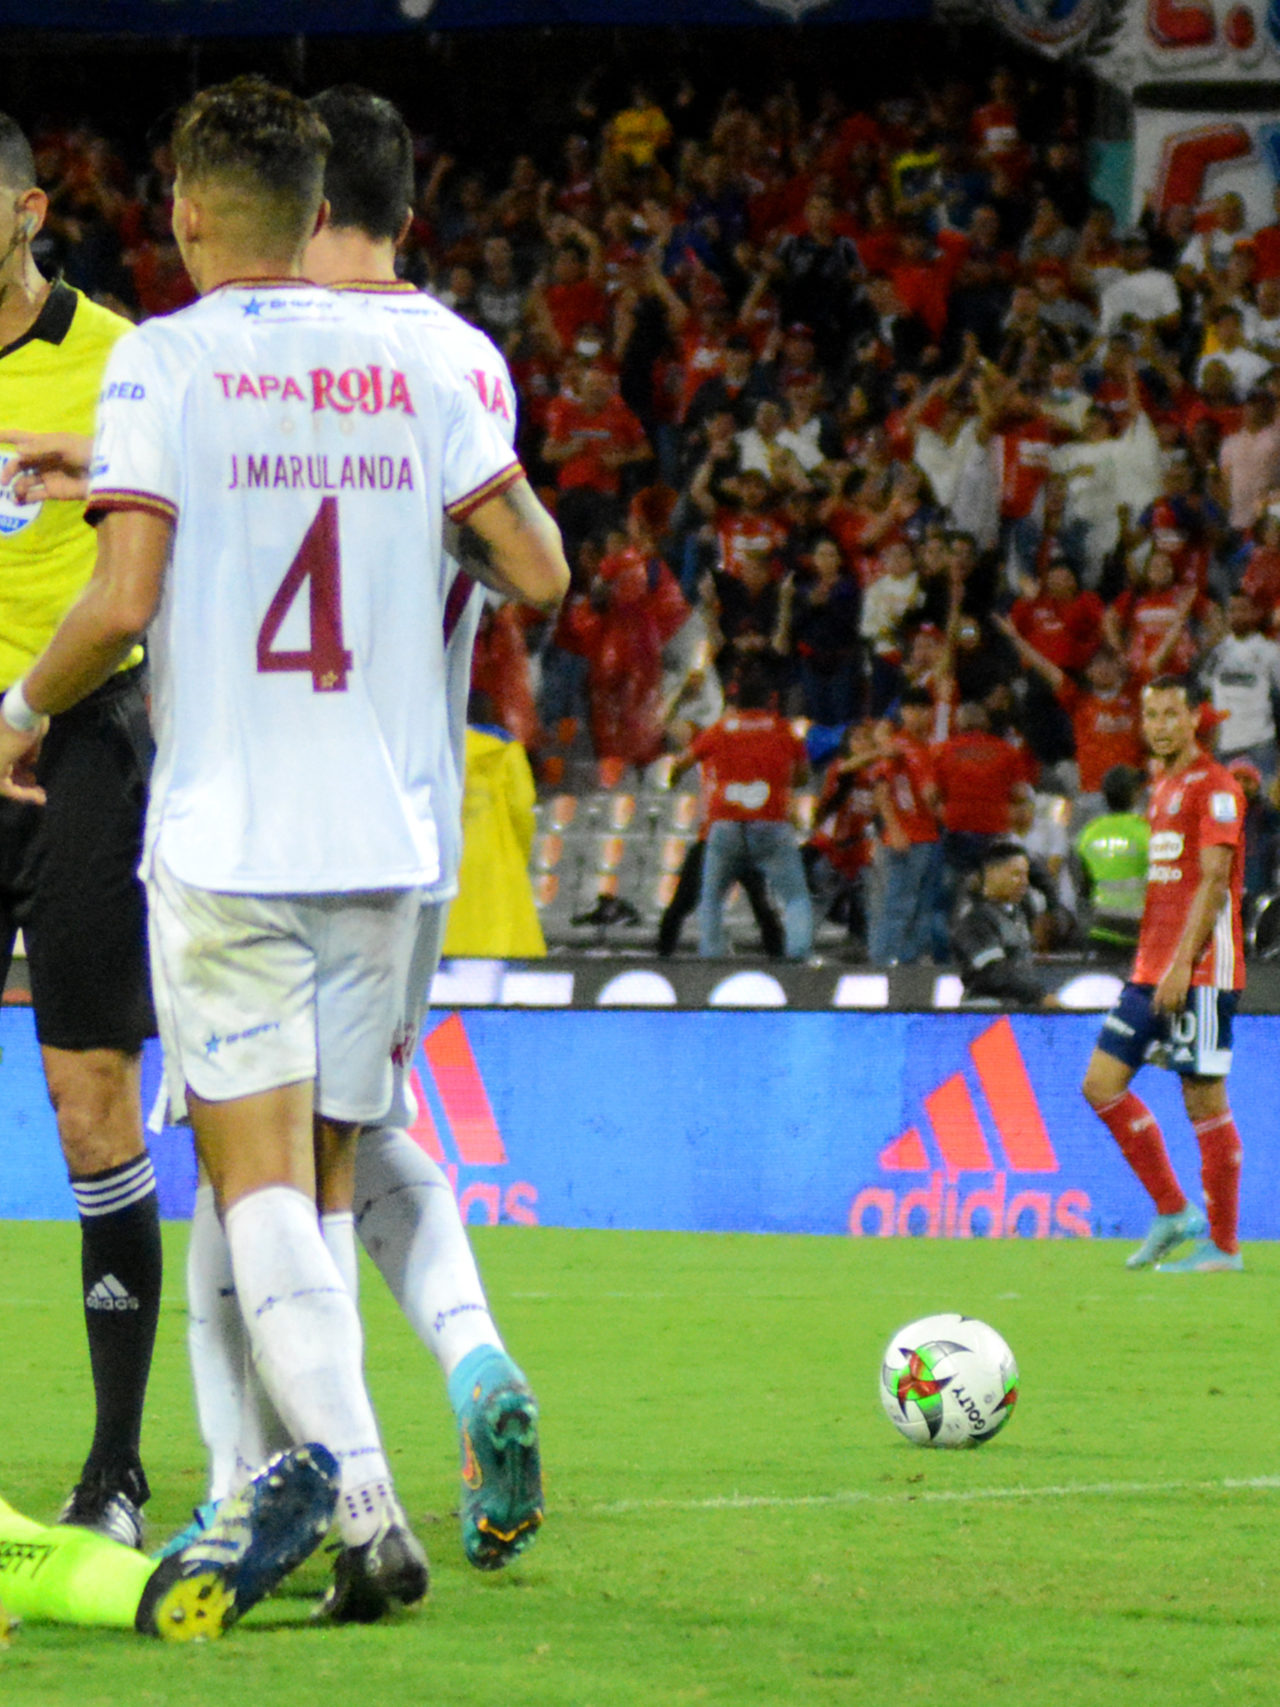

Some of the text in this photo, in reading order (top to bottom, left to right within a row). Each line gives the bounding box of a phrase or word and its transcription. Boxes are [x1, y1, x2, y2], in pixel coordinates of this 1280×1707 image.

[214, 364, 417, 418] TAPA ROJA
[228, 454, 415, 492] J.MARULANDA
[256, 496, 355, 693] 4
[849, 1170, 1093, 1239] adidas
[951, 1385, 987, 1431] GOLTY
